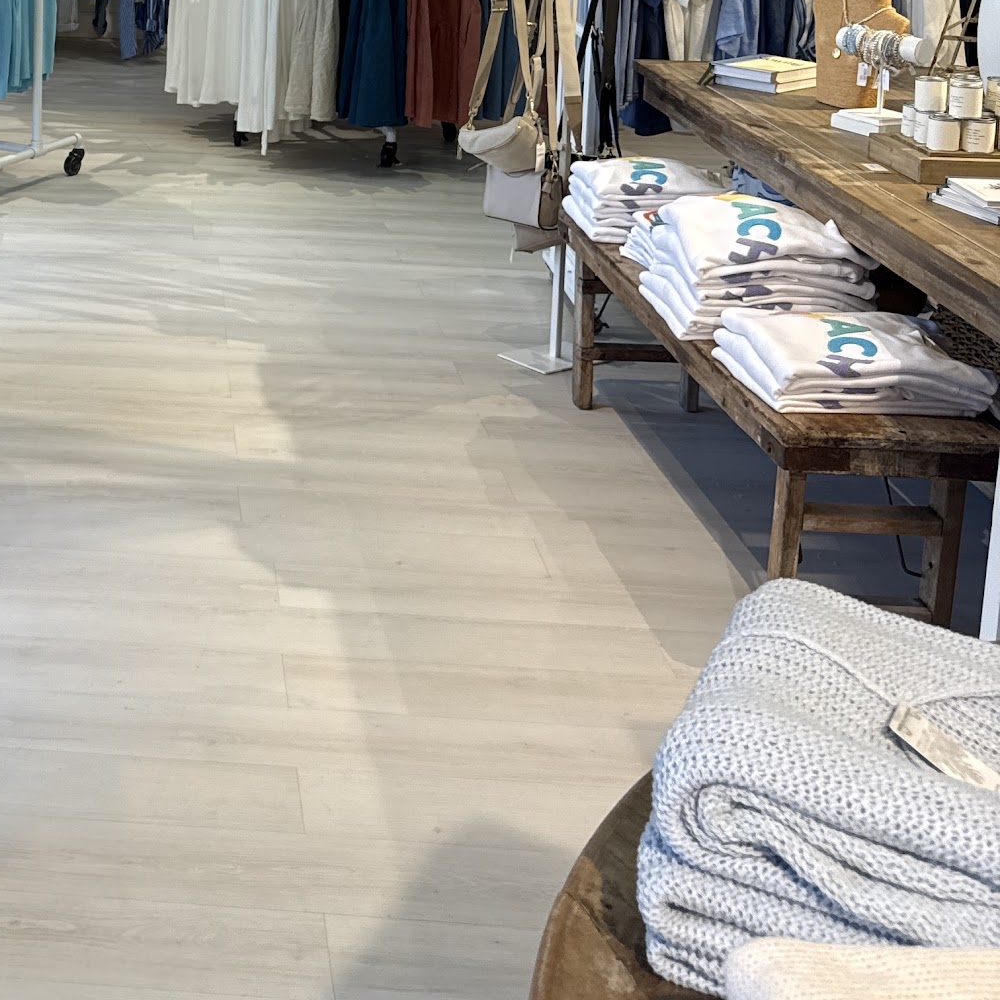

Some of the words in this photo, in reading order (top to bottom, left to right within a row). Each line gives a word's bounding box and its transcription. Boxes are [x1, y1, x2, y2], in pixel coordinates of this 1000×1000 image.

[620, 158, 668, 196] ACH
[716, 195, 782, 264] ACH
[814, 314, 878, 378] ACH
